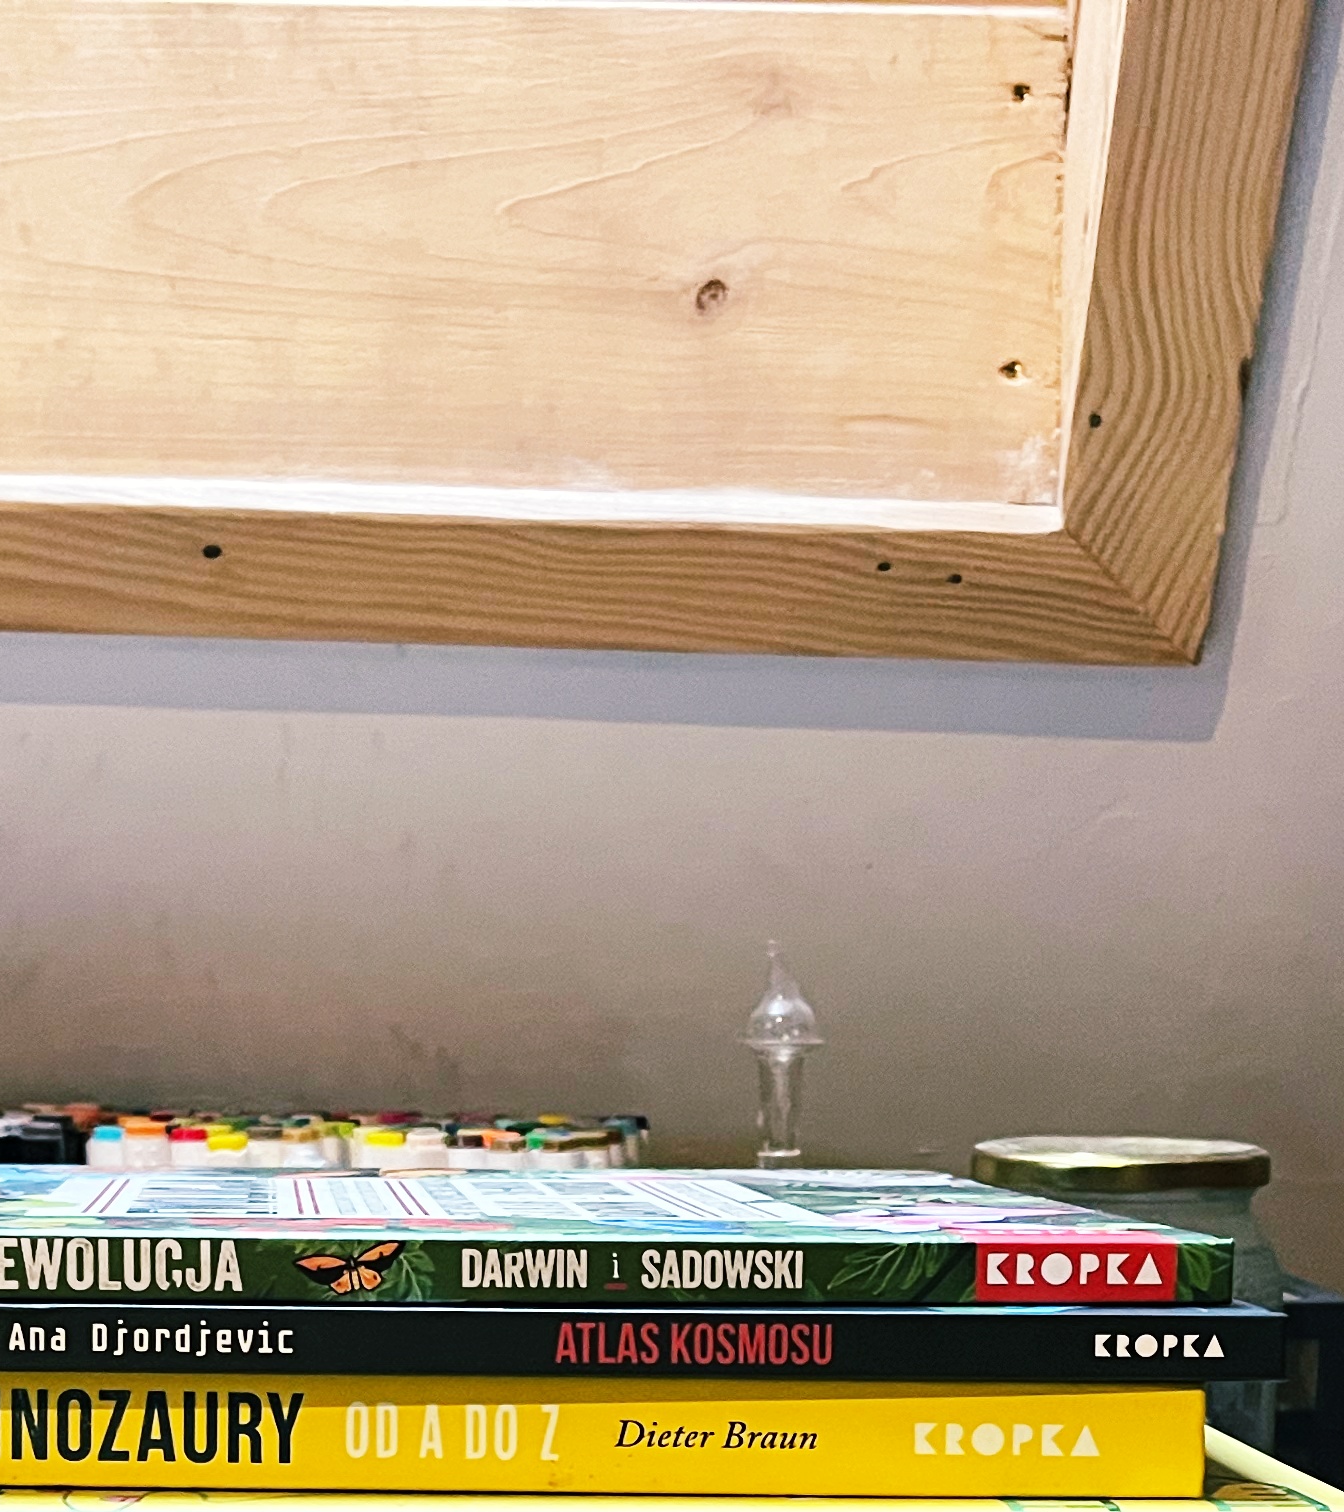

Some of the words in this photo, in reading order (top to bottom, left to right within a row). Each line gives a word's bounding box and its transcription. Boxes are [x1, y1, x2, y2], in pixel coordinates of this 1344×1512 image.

[461, 1248, 588, 1289] DARWIN
[612, 1252, 620, 1279] i
[640, 1248, 804, 1290] SADOWSKI
[986, 1252, 1163, 1286] KROPKA
[8, 1322, 66, 1352] Ana
[92, 1319, 294, 1357] Djordjevic
[555, 1321, 660, 1364] ATLAS
[670, 1322, 833, 1365] KOSMOSU
[1094, 1333, 1225, 1358] KROPKA
[345, 1401, 399, 1459] OD
[419, 1403, 444, 1459] A
[464, 1403, 518, 1461] DO
[540, 1403, 560, 1461] Z
[614, 1419, 715, 1448] Dieter
[721, 1421, 818, 1450] Braun
[914, 1422, 1100, 1457] KROPKA
